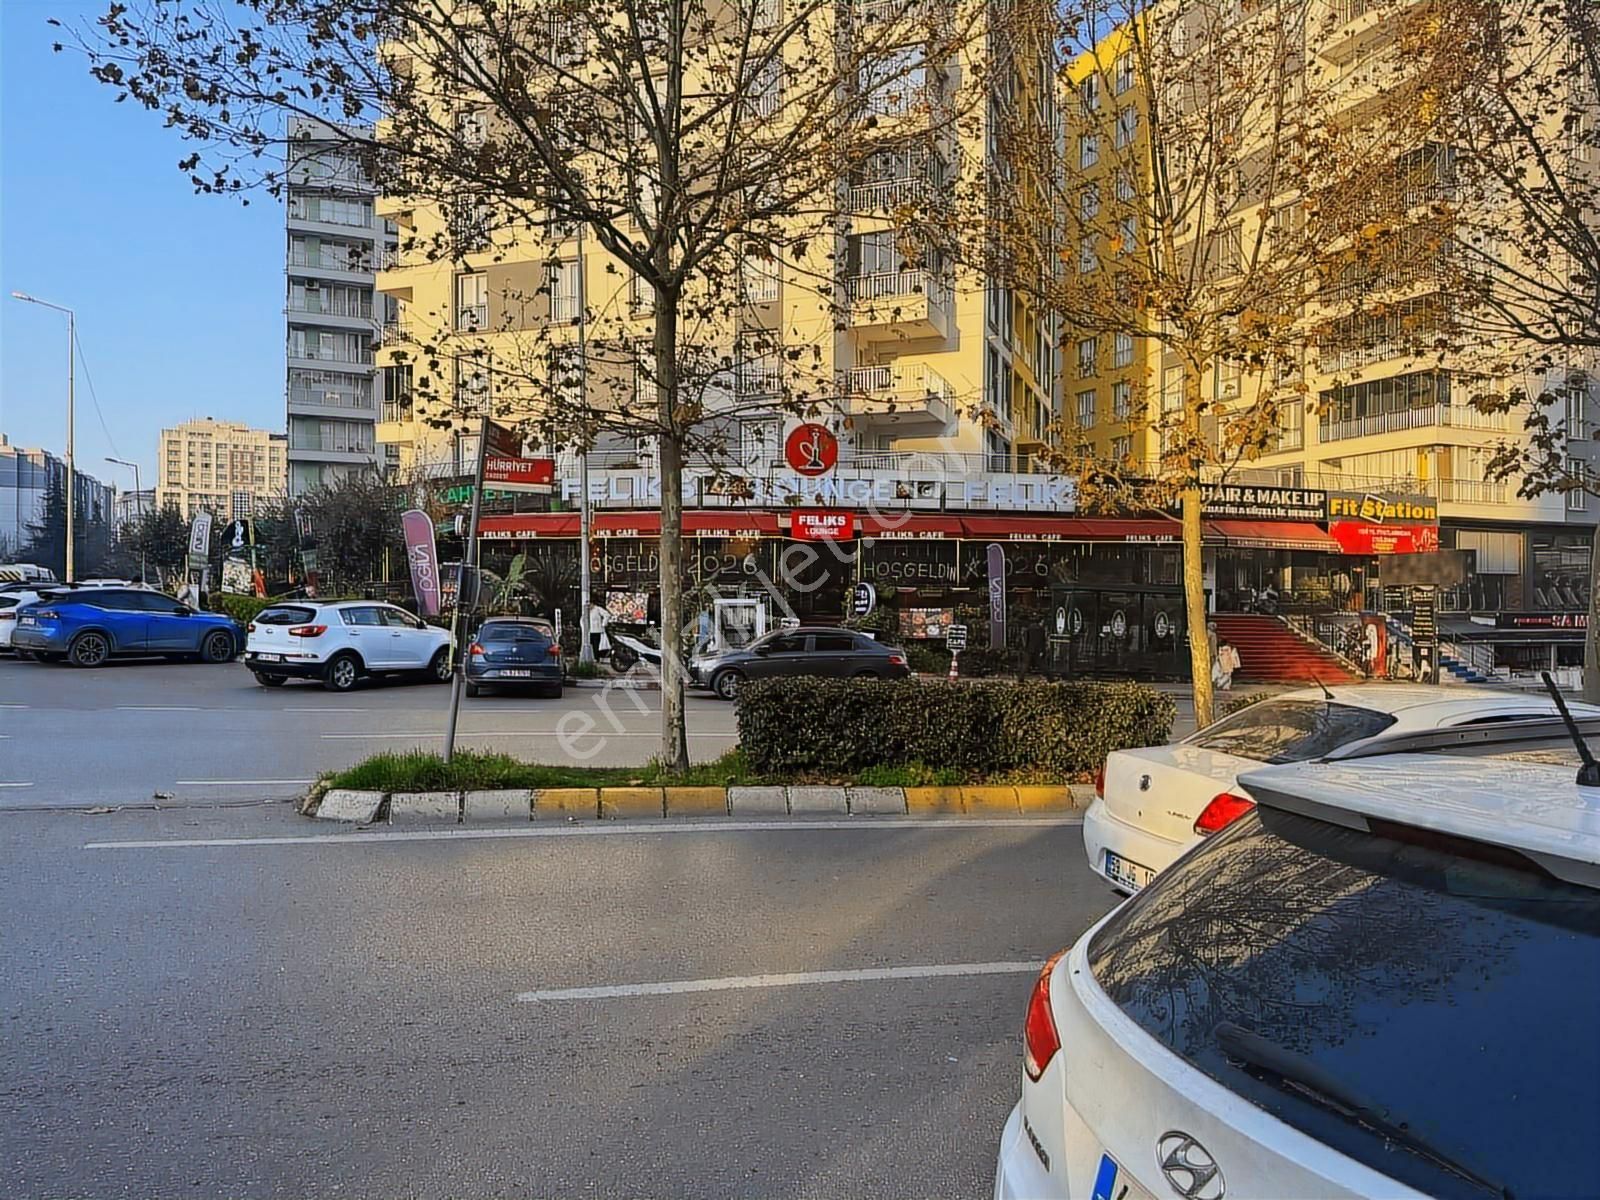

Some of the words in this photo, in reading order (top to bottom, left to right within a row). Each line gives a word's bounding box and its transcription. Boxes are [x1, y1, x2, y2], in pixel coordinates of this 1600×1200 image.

[486, 458, 533, 473] HÜRRİYET
[1201, 486, 1241, 502] HAIR
[1243, 488, 1255, 503] &
[1257, 489, 1302, 505] MAKE
[1304, 491, 1325, 506] UP
[1330, 498, 1358, 516] Fit
[1363, 500, 1436, 519] Station
[798, 515, 846, 526] FELIKS
[484, 530, 512, 538] FELIKS
[516, 530, 537, 538] CAFE
[616, 528, 638, 537] CAFE
[696, 529, 730, 537] FELIKS
[735, 529, 761, 537] CAFE
[805, 527, 839, 536] LOUNGE
[880, 531, 914, 539] FELIKS
[919, 531, 944, 539] CAFE
